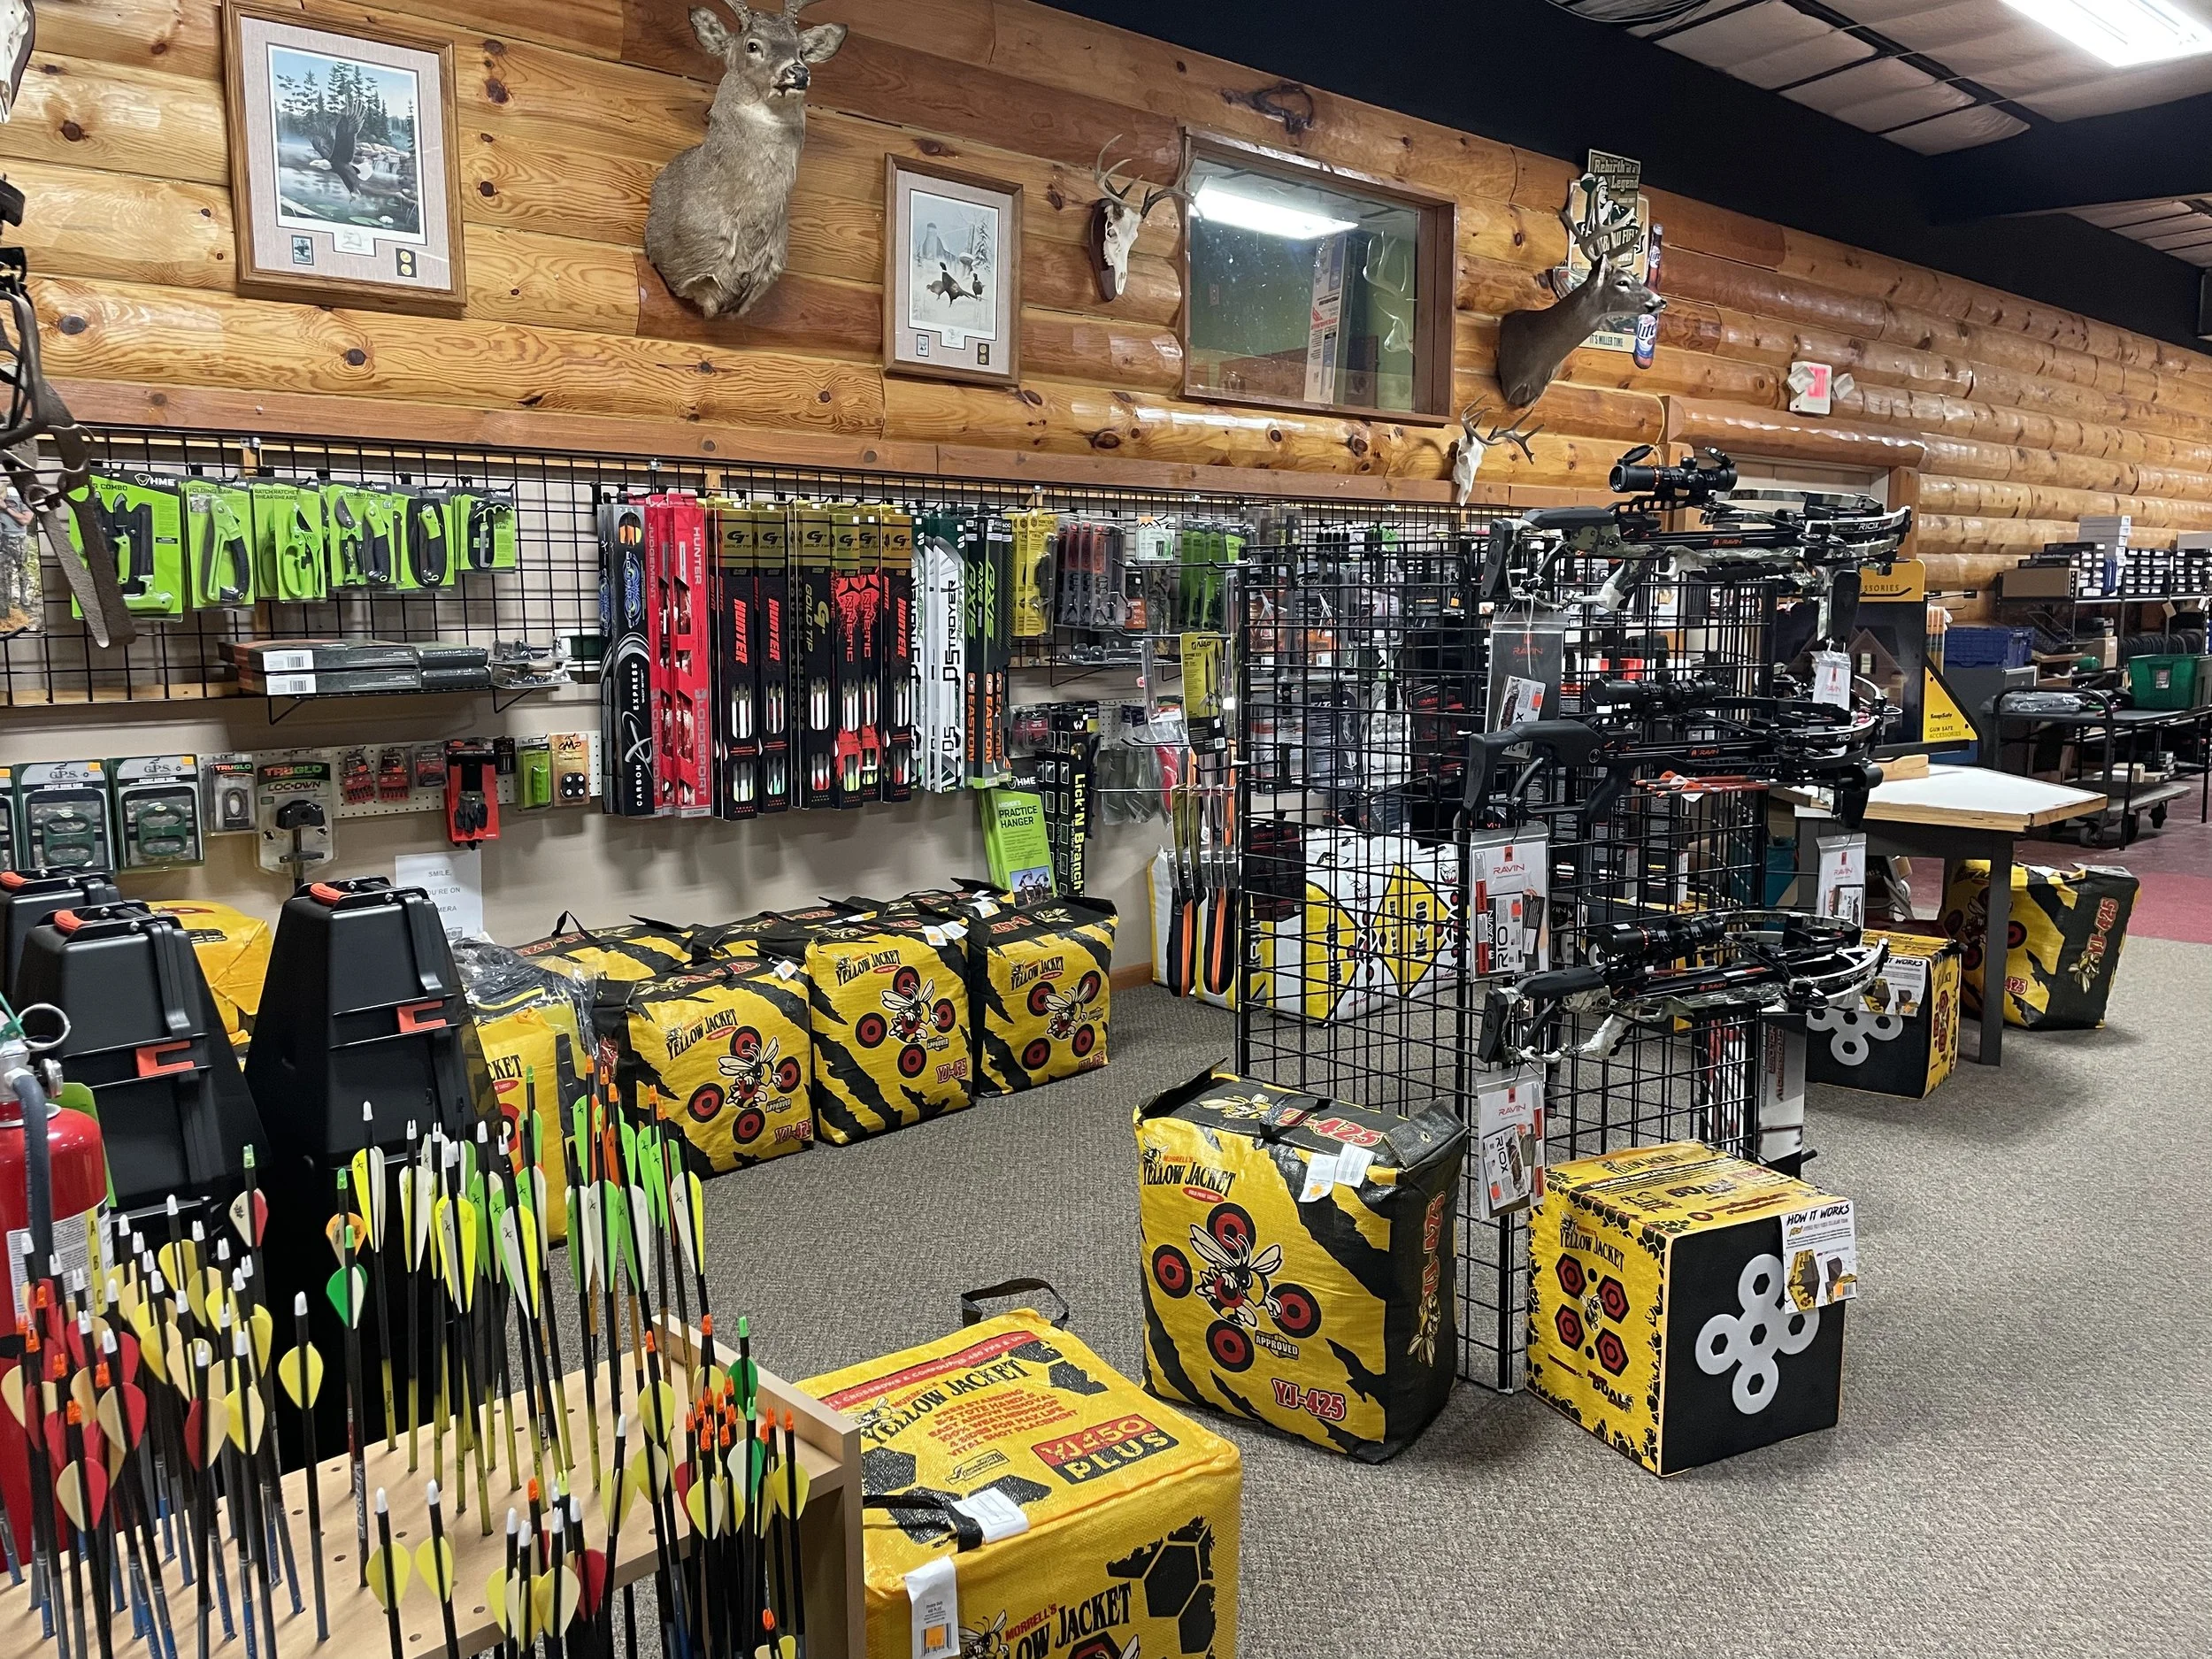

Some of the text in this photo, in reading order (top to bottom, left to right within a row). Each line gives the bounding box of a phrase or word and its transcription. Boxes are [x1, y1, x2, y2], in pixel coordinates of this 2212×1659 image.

[1594, 158, 1625, 173] Rebirth
[1610, 176, 1638, 193] Legend
[1599, 335, 1612, 346] MILLER
[1613, 336, 1624, 347] TIME
[1639, 323, 1655, 340] Lite
[150, 474, 175, 487] HME
[966, 563, 977, 643] AXIS
[733, 598, 748, 664] HUNTER
[769, 598, 780, 661] HUNTER
[844, 595, 854, 662] KINETIC
[863, 592, 872, 657] KINETIC
[897, 597, 907, 658] HUNTER
[1512, 647, 1543, 657] RAVIN
[695, 688, 707, 796] BLOODSPORT
[265, 765, 322, 776] TRUGLO
[1018, 777, 1036, 787] HME
[999, 806, 1038, 818] PRACTICE
[1001, 817, 1034, 829] HANGER
[1073, 773, 1086, 891] Lick'N Branch
[1493, 864, 1525, 874] RAVIN
[2087, 897, 2119, 956] YJ-425
[835, 950, 902, 987] YELLOW JACKET
[1010, 956, 1064, 991] YELLOW JACKET
[666, 1009, 739, 1061] YELLOW JACKET
[487, 1055, 523, 1080] CKET
[936, 1058, 967, 1084] YJ-425
[1776, 1028, 1785, 1102] CROSSBOW
[766, 1098, 791, 1113] APPROVED
[1498, 1103, 1526, 1116] RAVIN
[1143, 1161, 1236, 1198] YELLOW JACKET
[90, 1220, 96, 1236] A
[1786, 1204, 1850, 1226] HOW IT WORKS
[1422, 1191, 1446, 1298] YJ-425
[1560, 1227, 1624, 1273] YELLOW JACKET
[93, 1256, 99, 1271] B
[96, 1290, 103, 1304] C
[1256, 1334, 1299, 1356] APPROVED
[843, 1377, 902, 1402] CROSSBOWS
[911, 1357, 966, 1379] COMPOUNDS
[980, 1343, 1001, 1356] FPS
[861, 1359, 1032, 1444] YELLOW JACKET
[890, 1382, 938, 1409] MORRELL'S
[934, 1389, 1025, 1417] FREE STANDING
[990, 1392, 1034, 1409] HANDLE
[1271, 1378, 1347, 1421] YJ-425
[928, 1393, 1057, 1438] EASY ARROW REMOVAL
[939, 1400, 1059, 1441] 100% WEATHERPROOF
[948, 1409, 1079, 1457] VITAL SHOT PLACEMENT
[958, 1427, 992, 1445] SIDES
[993, 1421, 1014, 1433] FOR
[1016, 1414, 1037, 1428] MAX
[1038, 1406, 1065, 1422] LIFE
[1064, 1432, 1168, 1480] PLUS
[1005, 1603, 1057, 1642] MORRELL'S
[1055, 1580, 1133, 1649] JACKET
